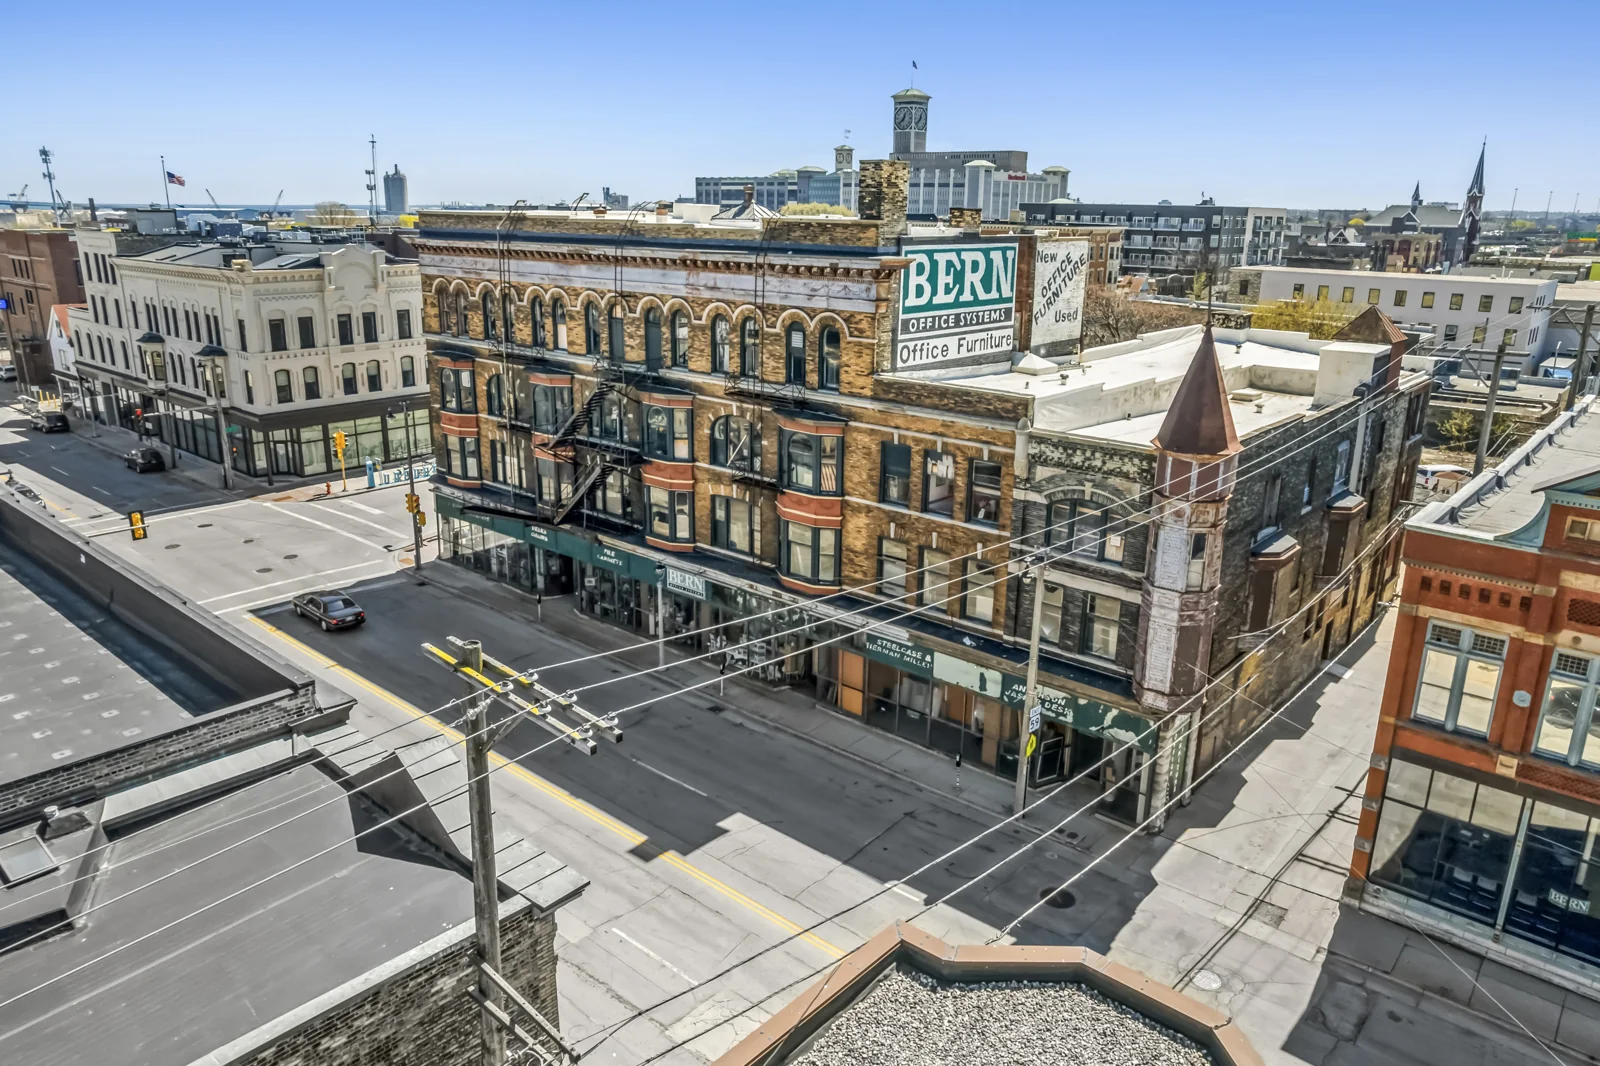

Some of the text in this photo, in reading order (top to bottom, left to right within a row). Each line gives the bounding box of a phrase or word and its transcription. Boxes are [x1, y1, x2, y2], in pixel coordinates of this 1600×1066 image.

[1036, 250, 1058, 263] New
[904, 250, 1015, 307] BERN
[1041, 252, 1073, 299] OFFICE
[1033, 253, 1086, 325] FURNITURE
[909, 309, 1006, 332] OFFICE SYSTEMS
[1054, 307, 1079, 324] Used
[900, 332, 1012, 364] Office Furniture
[668, 568, 703, 591] BERN
[877, 639, 932, 662] STEELCASE &
[1030, 717, 1040, 730] 59
[1551, 891, 1588, 910] BERN
